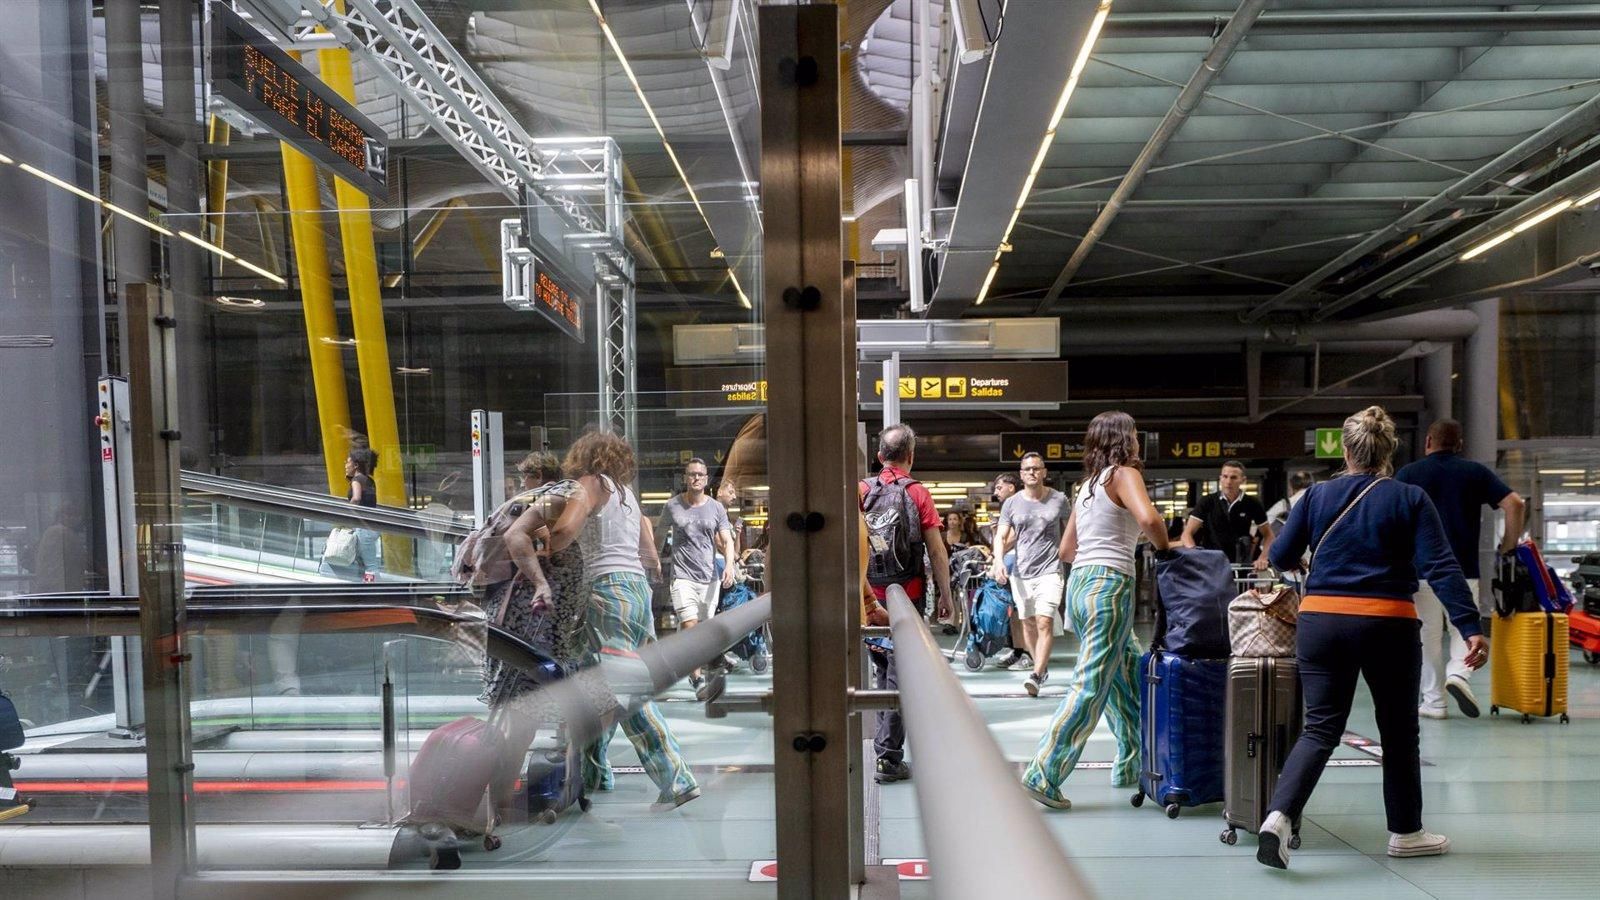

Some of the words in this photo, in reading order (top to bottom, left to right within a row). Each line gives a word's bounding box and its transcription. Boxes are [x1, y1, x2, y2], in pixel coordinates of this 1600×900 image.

[244, 44, 299, 101] SUELTE
[307, 90, 323, 118] LA
[330, 107, 366, 149] BARRA
[245, 70, 255, 93] Y
[264, 83, 299, 126] PARE
[307, 114, 323, 142] EL
[330, 131, 366, 171] CARRO
[971, 378, 1009, 387] Departures
[971, 387, 1003, 396] Salidas
